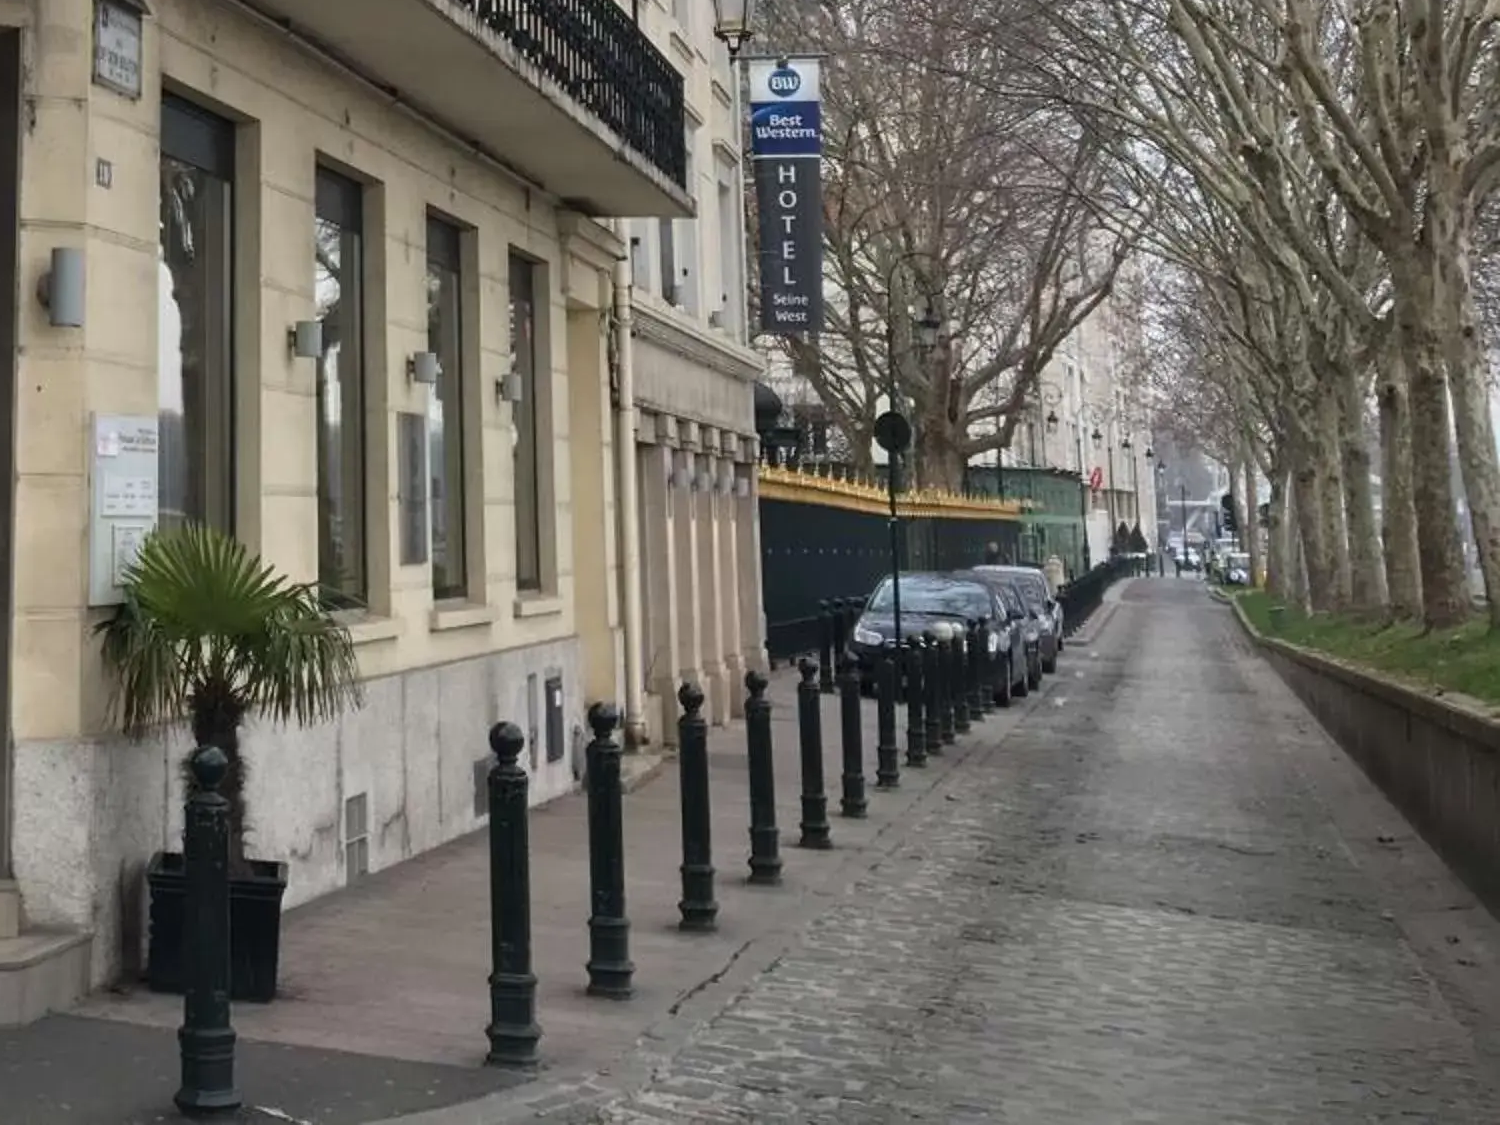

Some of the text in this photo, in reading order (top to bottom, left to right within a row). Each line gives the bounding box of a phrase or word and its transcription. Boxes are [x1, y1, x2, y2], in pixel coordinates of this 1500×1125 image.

[771, 76, 799, 90] BW
[769, 114, 803, 126] Best
[777, 165, 798, 285] HOTEL
[773, 293, 809, 306] Seine
[775, 311, 808, 323] West
